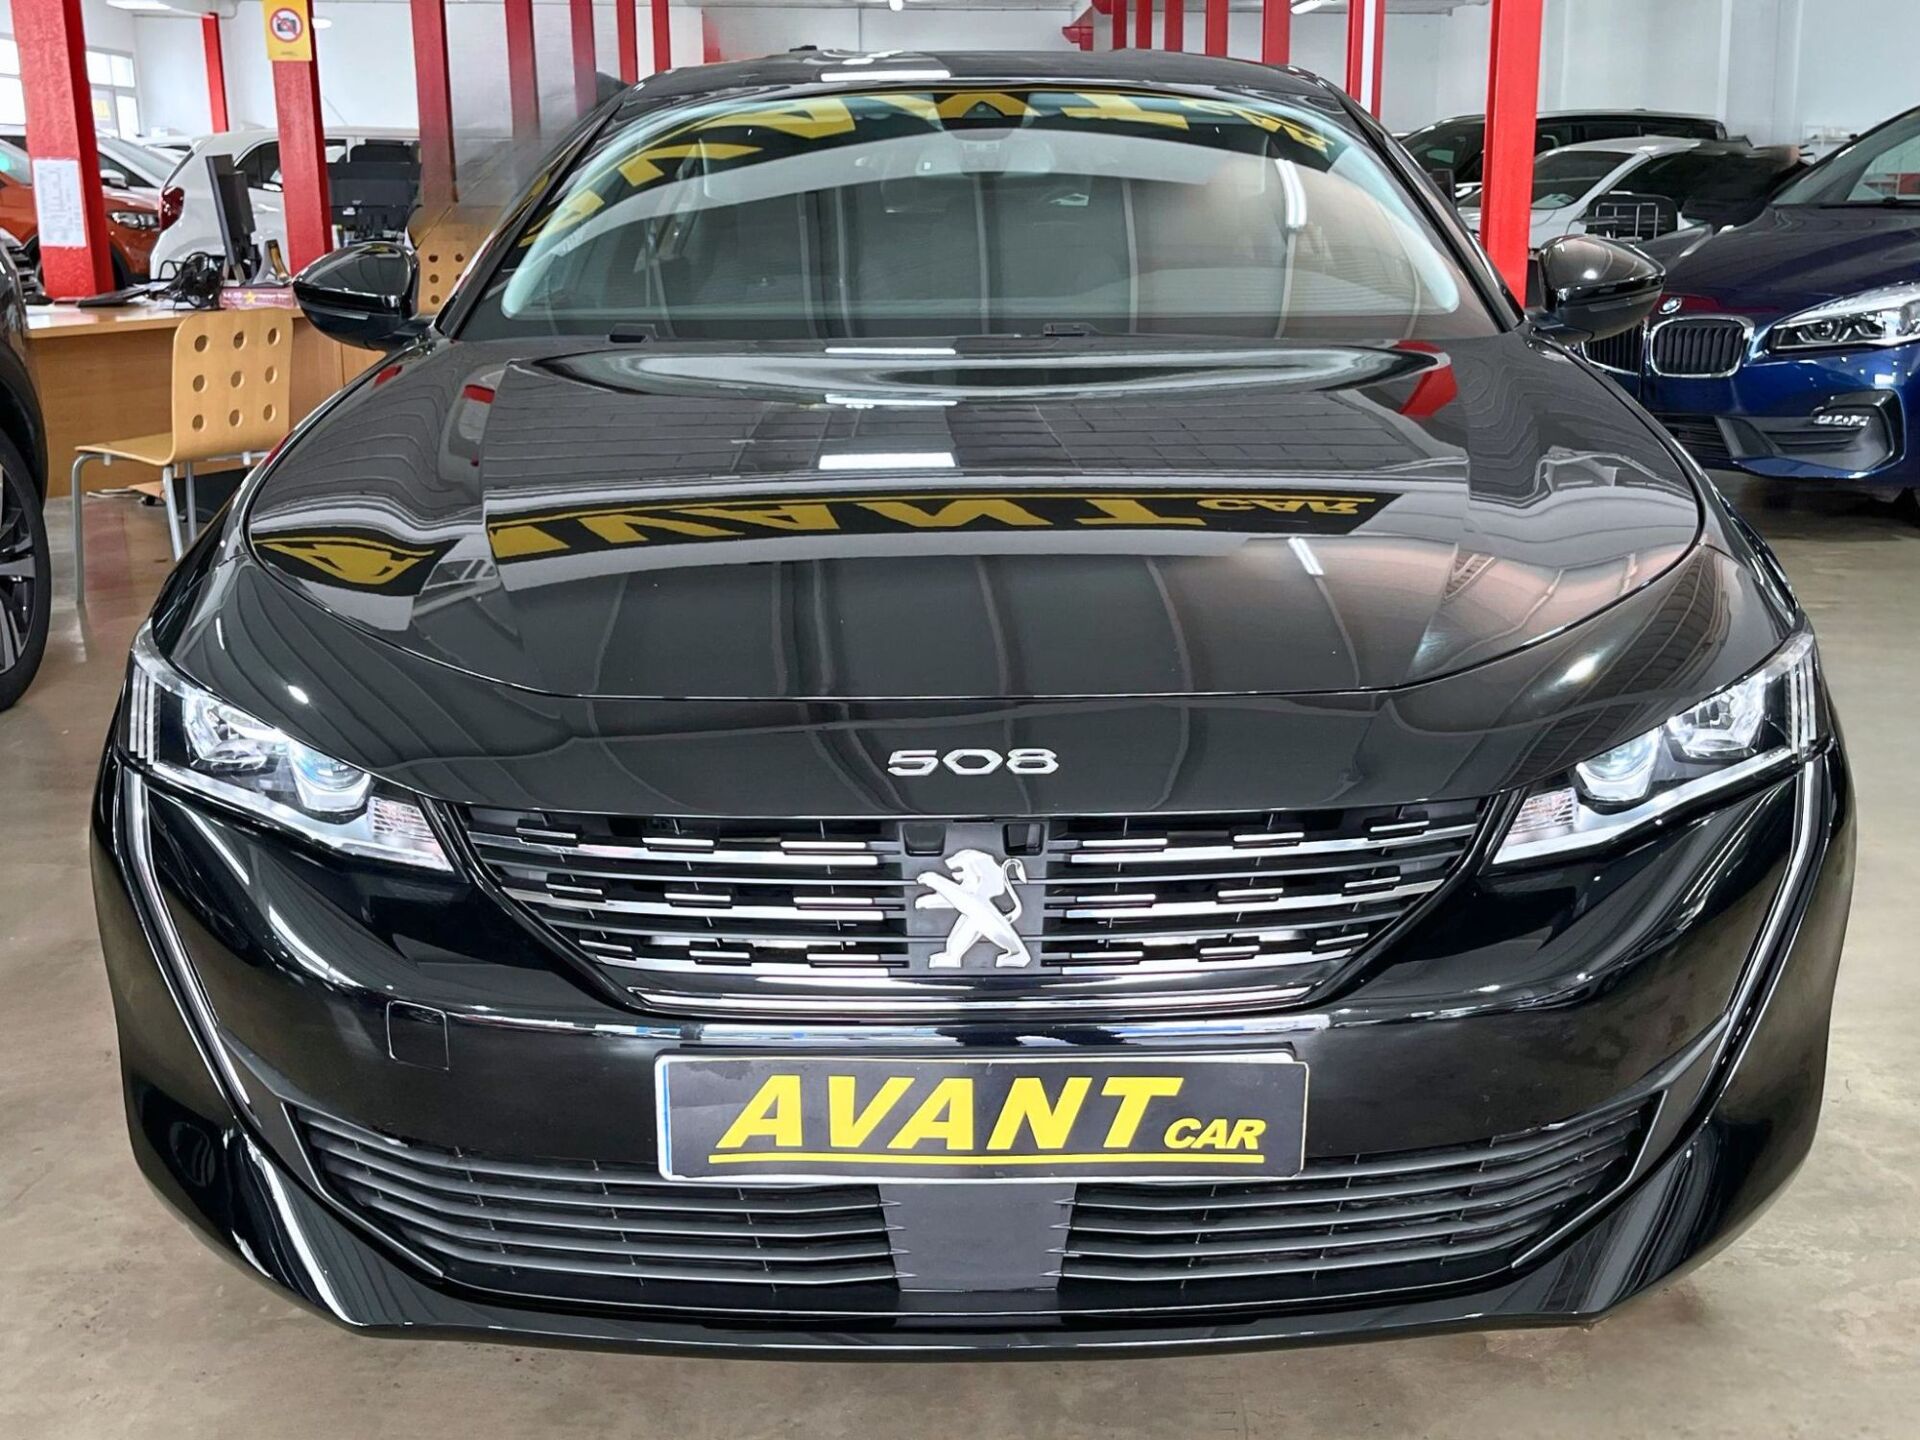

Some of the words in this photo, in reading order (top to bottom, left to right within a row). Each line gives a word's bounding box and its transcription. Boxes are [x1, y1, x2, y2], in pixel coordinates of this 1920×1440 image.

[887, 748, 1060, 777] 508
[715, 1074, 1185, 1150] AVANT
[1163, 1117, 1267, 1150] CAR
